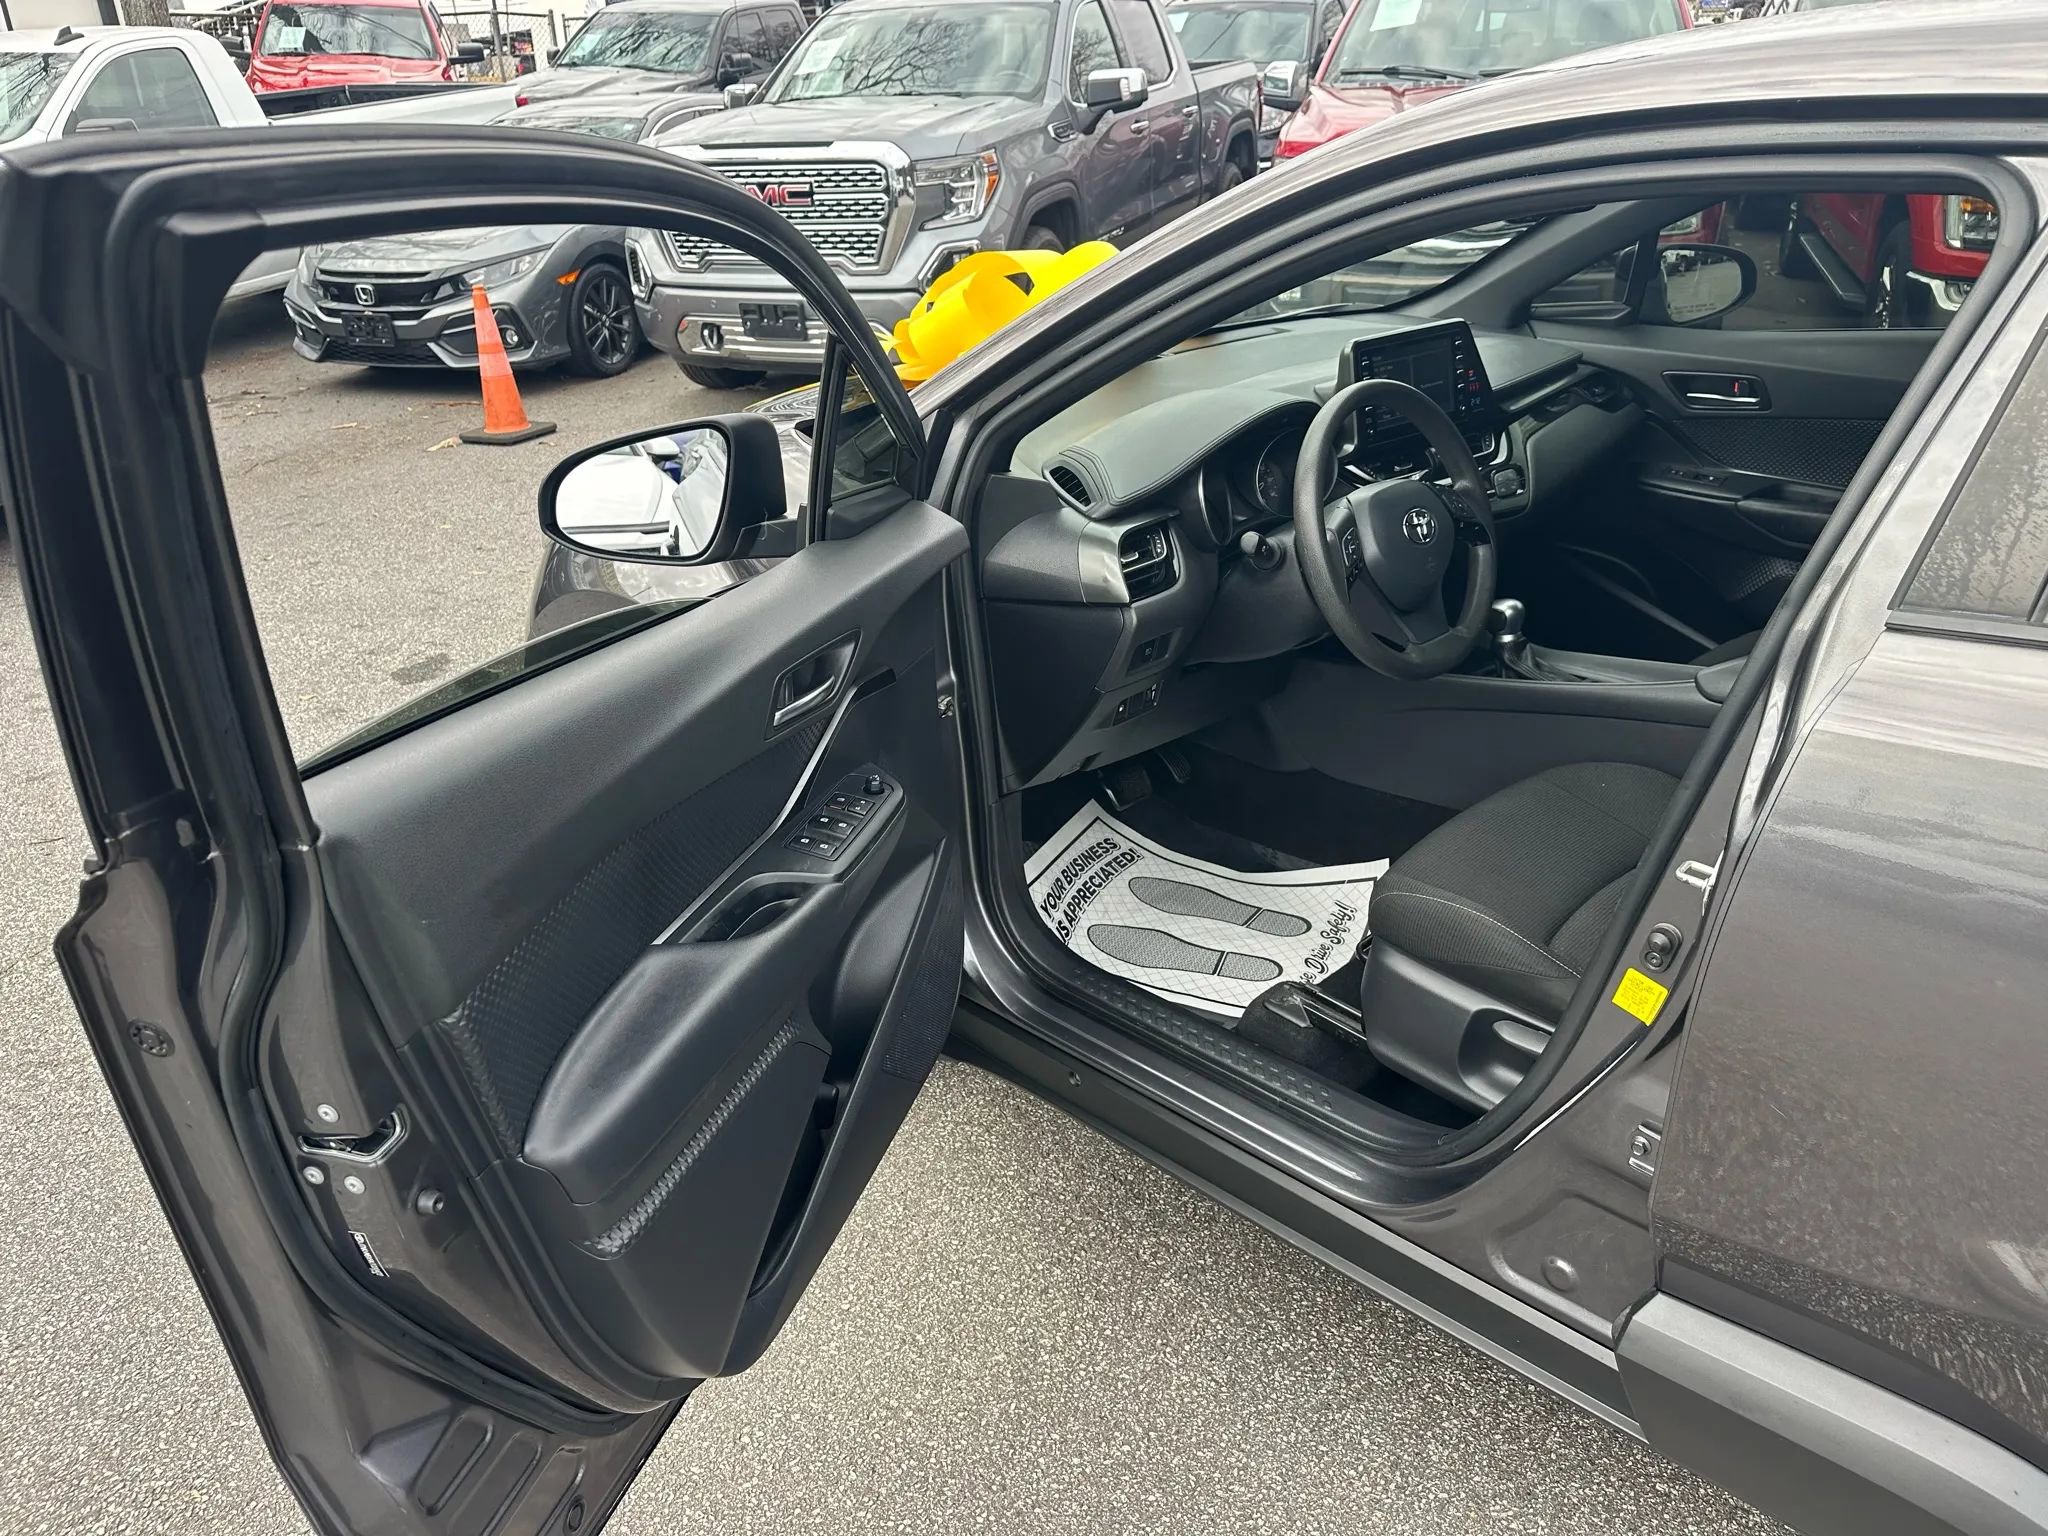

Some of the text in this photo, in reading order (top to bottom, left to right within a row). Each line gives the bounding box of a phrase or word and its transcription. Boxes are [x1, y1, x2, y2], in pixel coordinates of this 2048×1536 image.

[743, 183, 813, 206] MC
[1040, 838, 1120, 920] YOUR BUSINESS
[1055, 848, 1143, 944] IS APPRECIATED!
[1304, 944, 1332, 974] Drive
